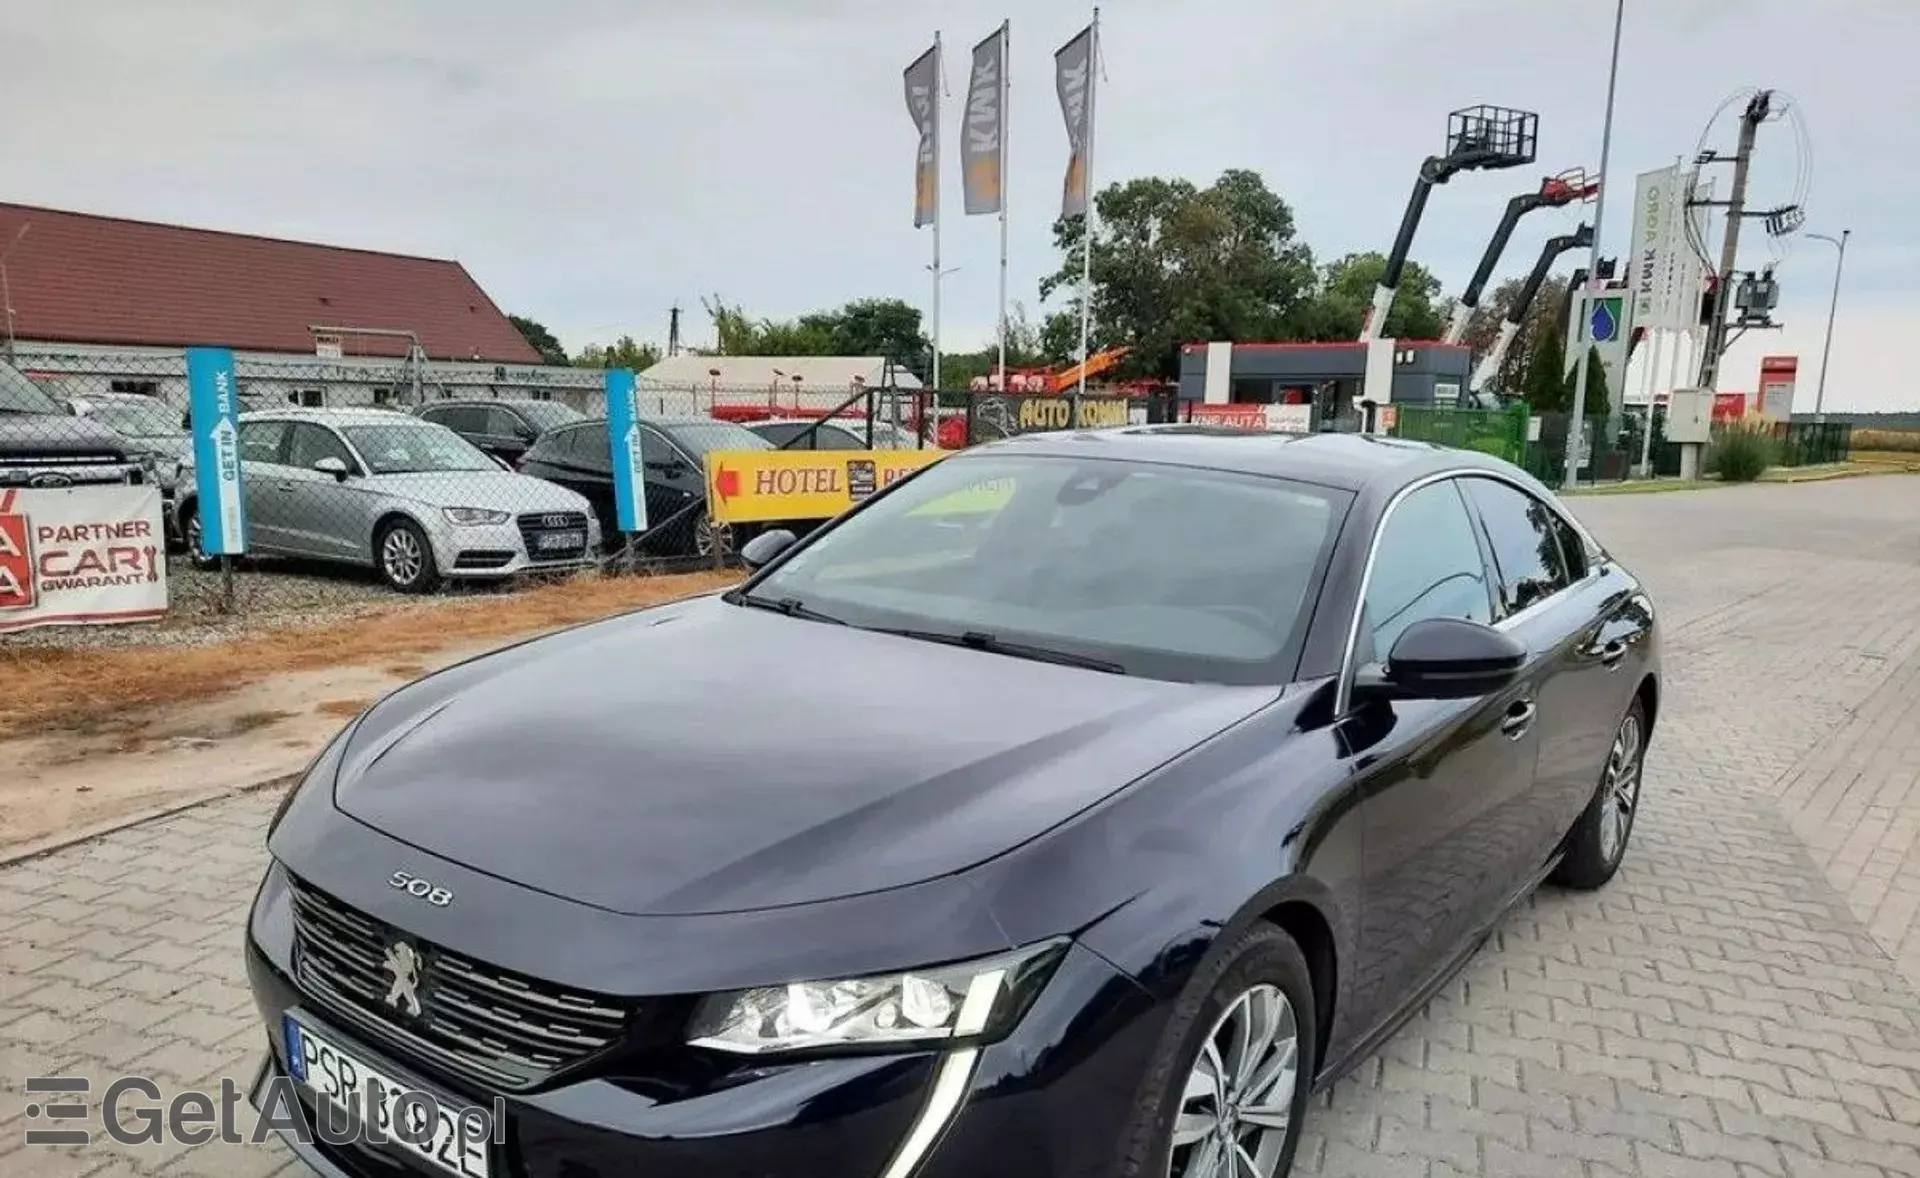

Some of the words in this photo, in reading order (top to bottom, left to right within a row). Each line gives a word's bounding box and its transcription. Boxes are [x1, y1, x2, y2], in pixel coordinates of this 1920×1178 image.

[215, 370, 230, 414] BANK
[1019, 398, 1070, 429] AUTO
[755, 468, 841, 496] HOTEL
[38, 521, 151, 543] PARTNER
[39, 546, 142, 577] CAR
[41, 573, 144, 592] GWARANT
[388, 871, 453, 906] 508
